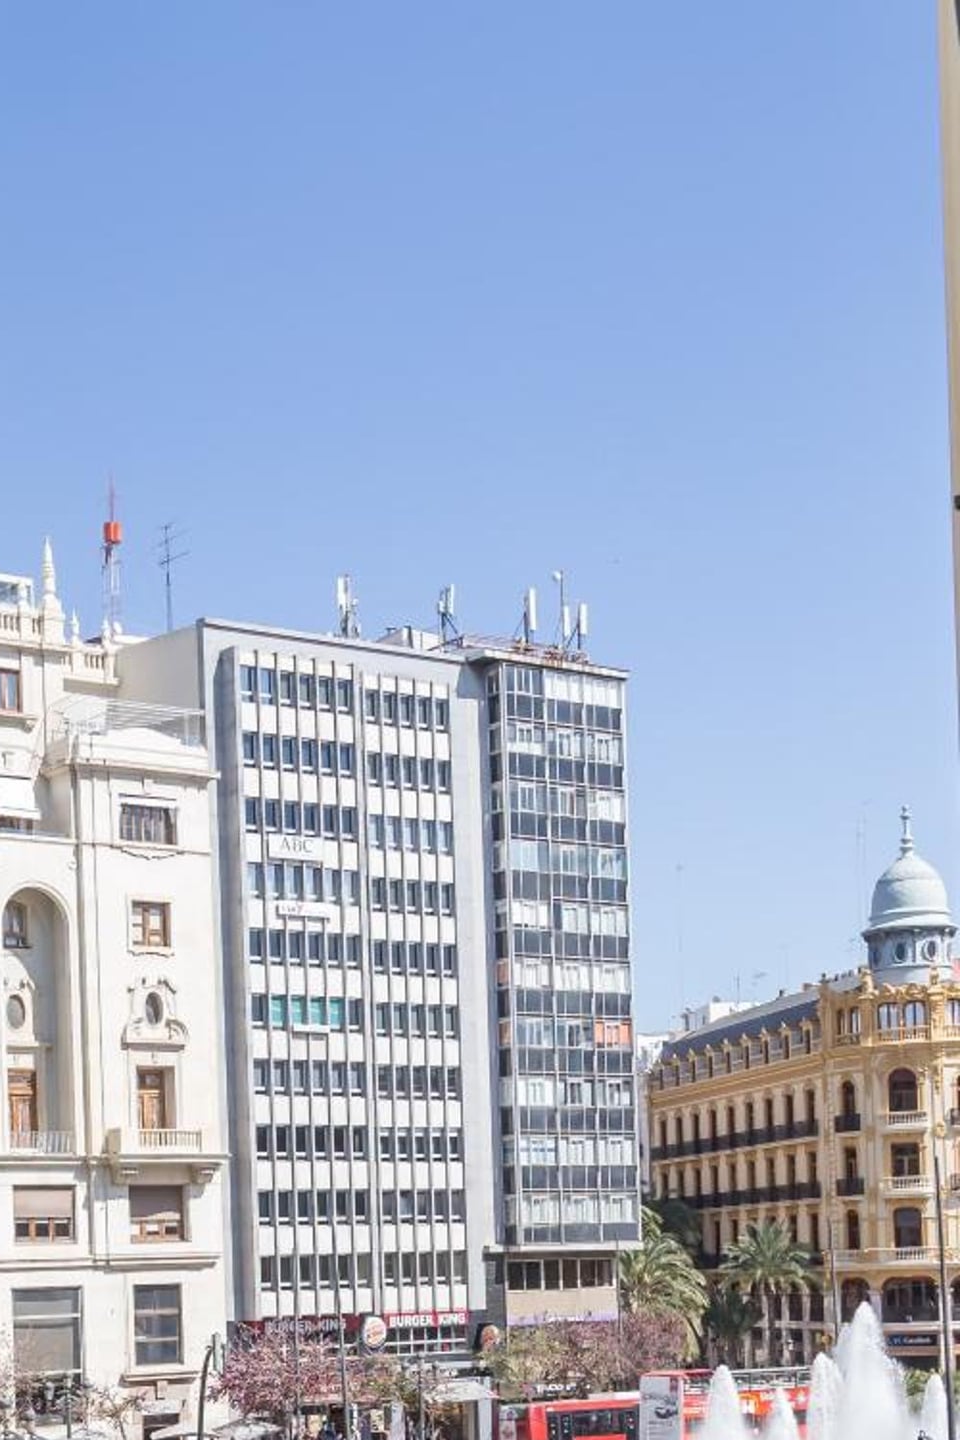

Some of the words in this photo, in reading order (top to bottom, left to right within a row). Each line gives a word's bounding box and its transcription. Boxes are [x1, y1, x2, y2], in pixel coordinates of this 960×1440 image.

[318, 1317, 347, 1331] KING
[390, 1315, 433, 1328] BURGER
[438, 1313, 466, 1325] KING
